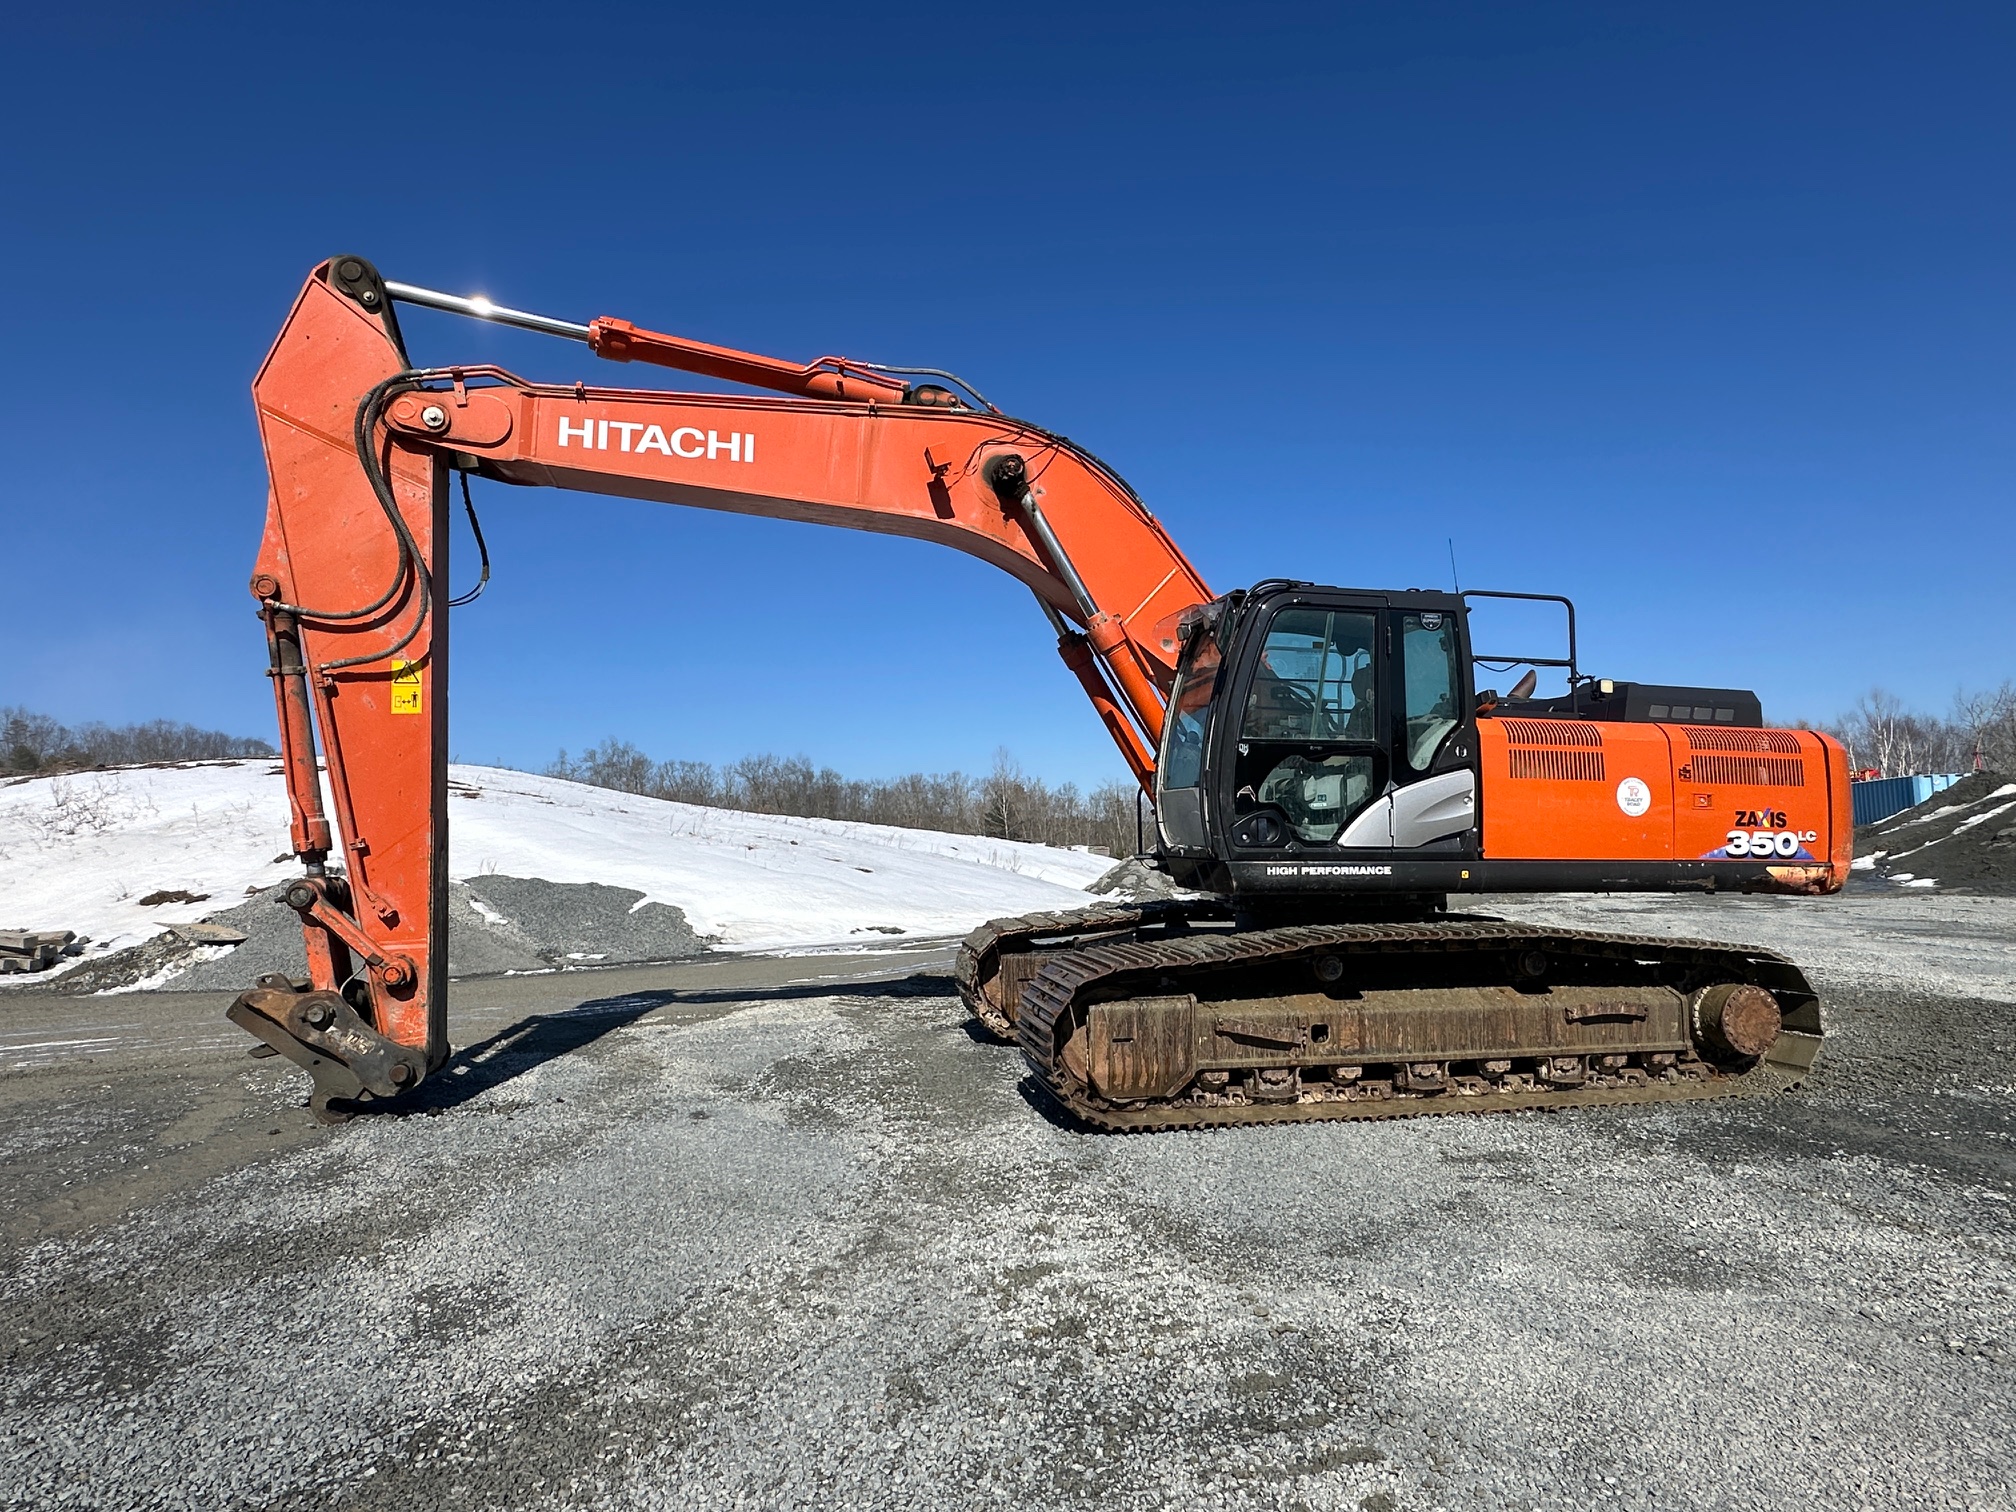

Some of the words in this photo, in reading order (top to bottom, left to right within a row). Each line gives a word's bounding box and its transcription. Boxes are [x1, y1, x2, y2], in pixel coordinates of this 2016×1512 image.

[558, 416, 755, 463] HITACHI
[1735, 807, 1787, 828] ZAXIS
[1266, 866, 1297, 876] HIGH
[1301, 866, 1392, 876] PERFORMANCE
